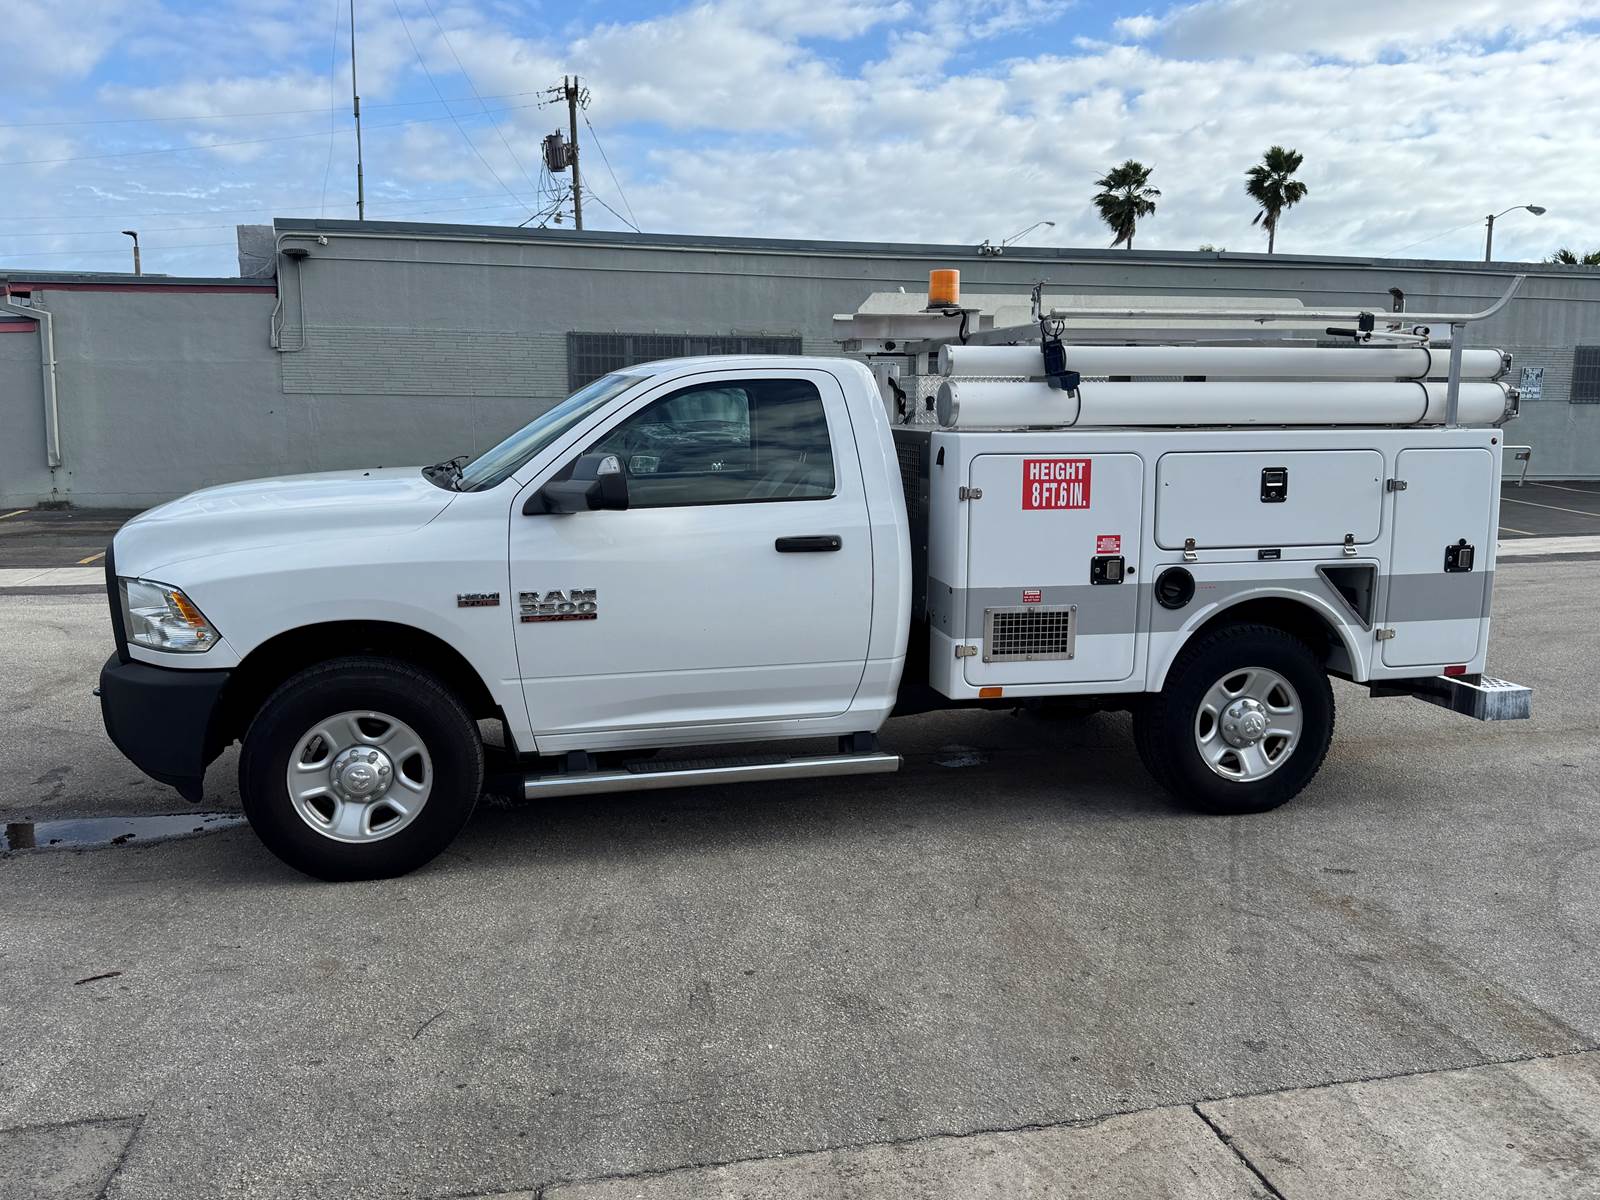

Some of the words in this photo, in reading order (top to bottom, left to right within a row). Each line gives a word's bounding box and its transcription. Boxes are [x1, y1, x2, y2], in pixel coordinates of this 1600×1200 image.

[1030, 463, 1086, 480] HEIGHT
[1032, 483, 1040, 507] 8
[519, 589, 597, 603] RAM
[520, 602, 597, 615] 3500
